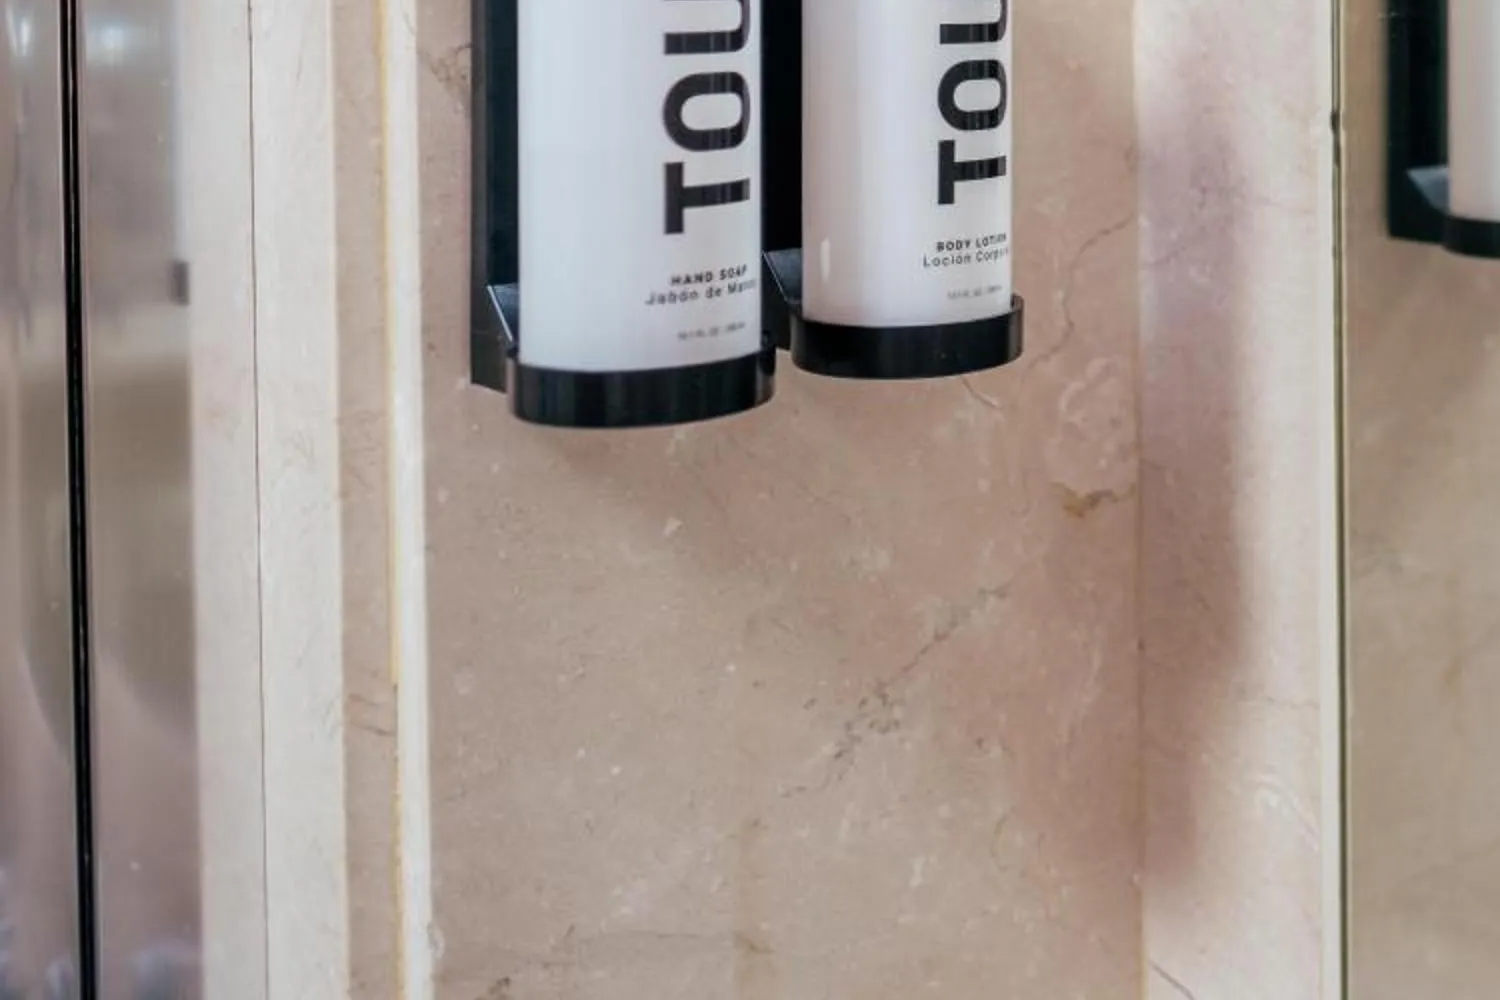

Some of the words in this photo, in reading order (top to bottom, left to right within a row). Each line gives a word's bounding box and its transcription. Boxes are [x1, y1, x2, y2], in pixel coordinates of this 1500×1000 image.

[936, 239, 971, 252] BODY
[670, 270, 714, 286] HAND
[705, 286, 722, 299] de
